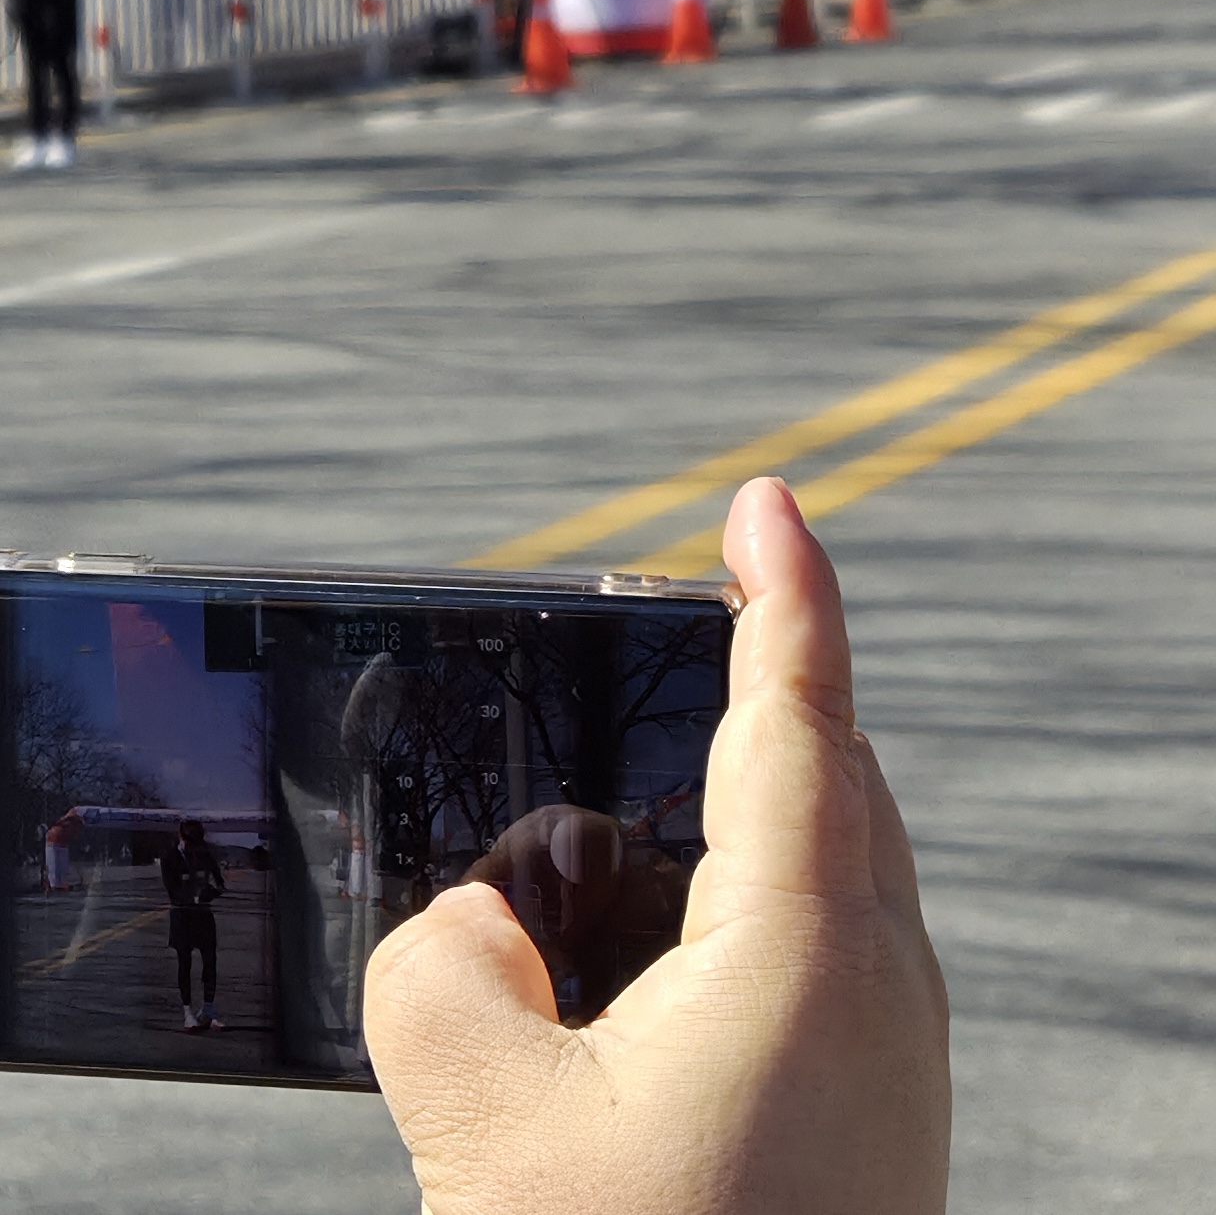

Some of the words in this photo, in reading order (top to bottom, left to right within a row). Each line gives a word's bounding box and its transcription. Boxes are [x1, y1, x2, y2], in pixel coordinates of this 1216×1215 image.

[477, 638, 504, 652] 100
[480, 705, 500, 719] 30
[396, 776, 413, 789] 10
[482, 772, 499, 785] 10
[400, 813, 409, 825] 3
[396, 853, 414, 865] 1x
